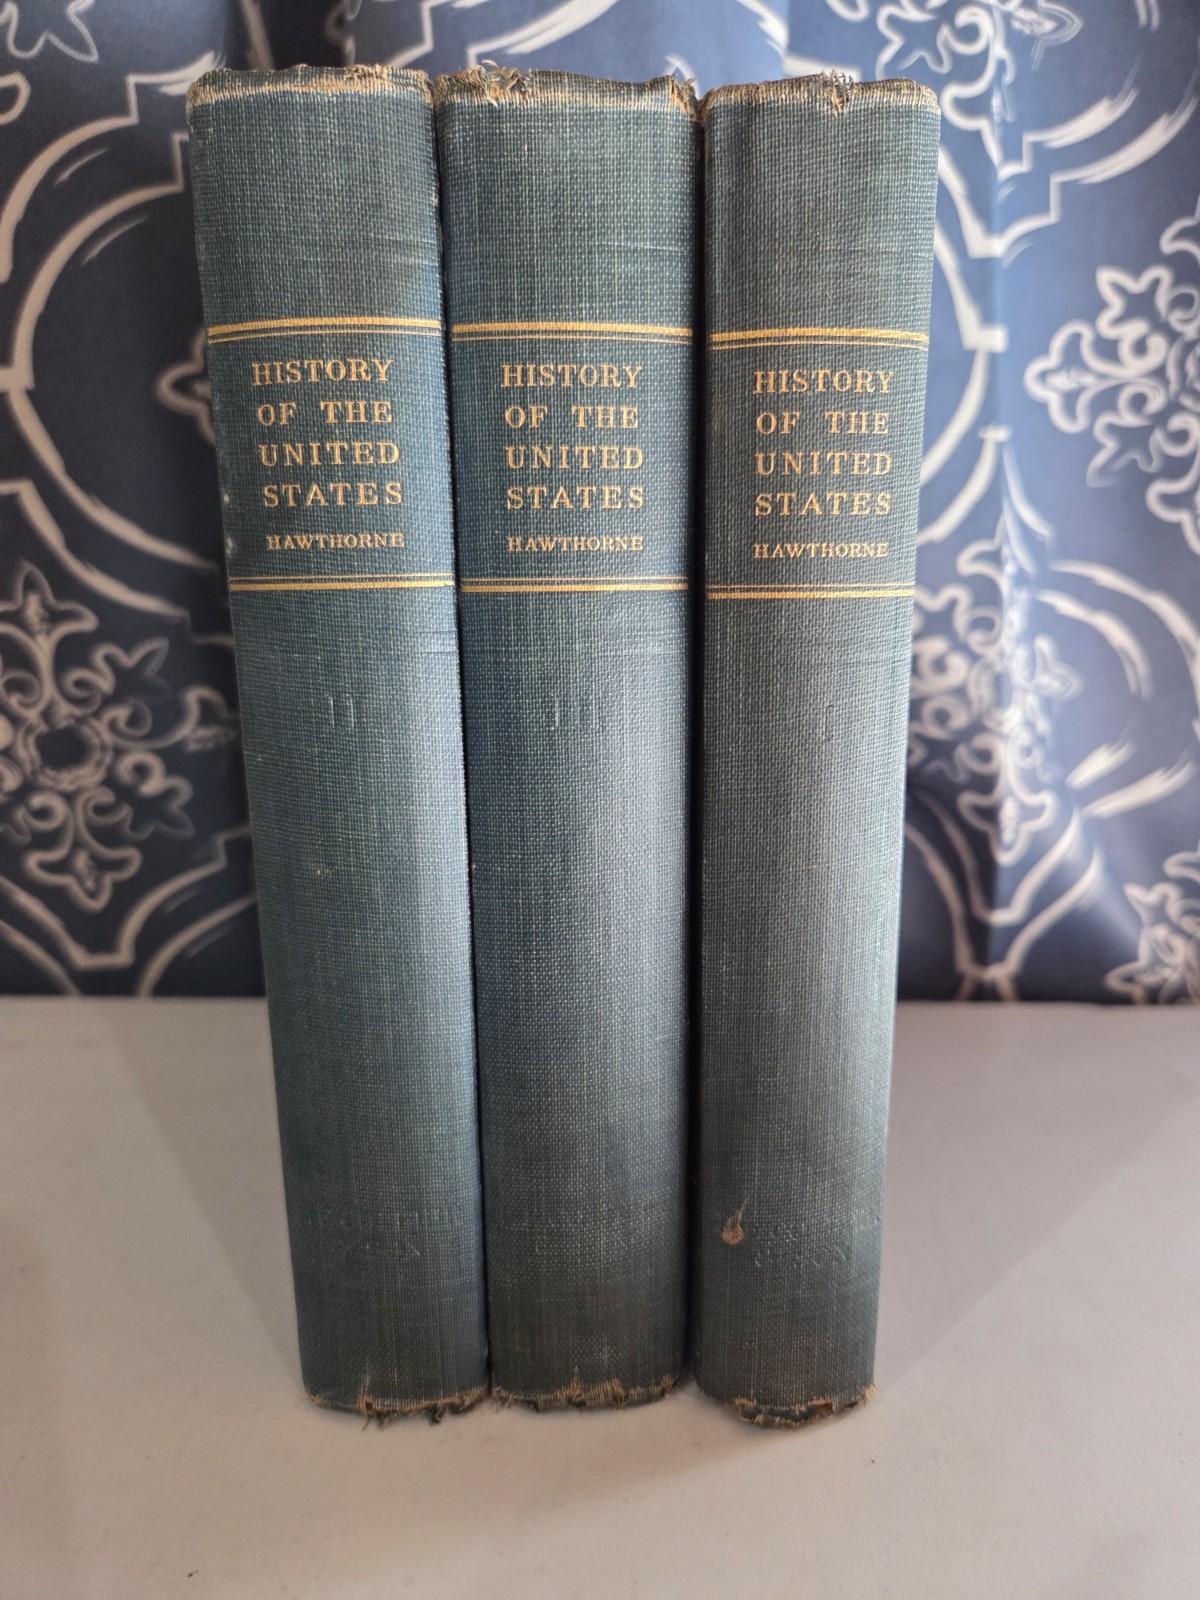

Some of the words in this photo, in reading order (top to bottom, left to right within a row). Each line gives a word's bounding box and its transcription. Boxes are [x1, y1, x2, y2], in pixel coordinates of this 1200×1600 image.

[252, 358, 394, 386] HISTORY
[501, 364, 642, 388] HISTORY
[753, 370, 895, 394] HISTORY
[257, 402, 297, 426] OF
[320, 400, 393, 424] THE
[505, 406, 548, 428] OF
[571, 406, 639, 428] THE
[756, 411, 800, 434] OF
[825, 411, 890, 434] THE
[258, 441, 400, 467] UNITED
[506, 446, 644, 469] UNITED
[755, 452, 893, 475] UNITED
[263, 482, 403, 507] STATES
[506, 486, 644, 510] STATES
[755, 492, 892, 517] STATES
[266, 532, 405, 550] HAWTHORNE
[507, 536, 644, 551] HAWTHORNE
[753, 543, 890, 559] HAWTHORNE
